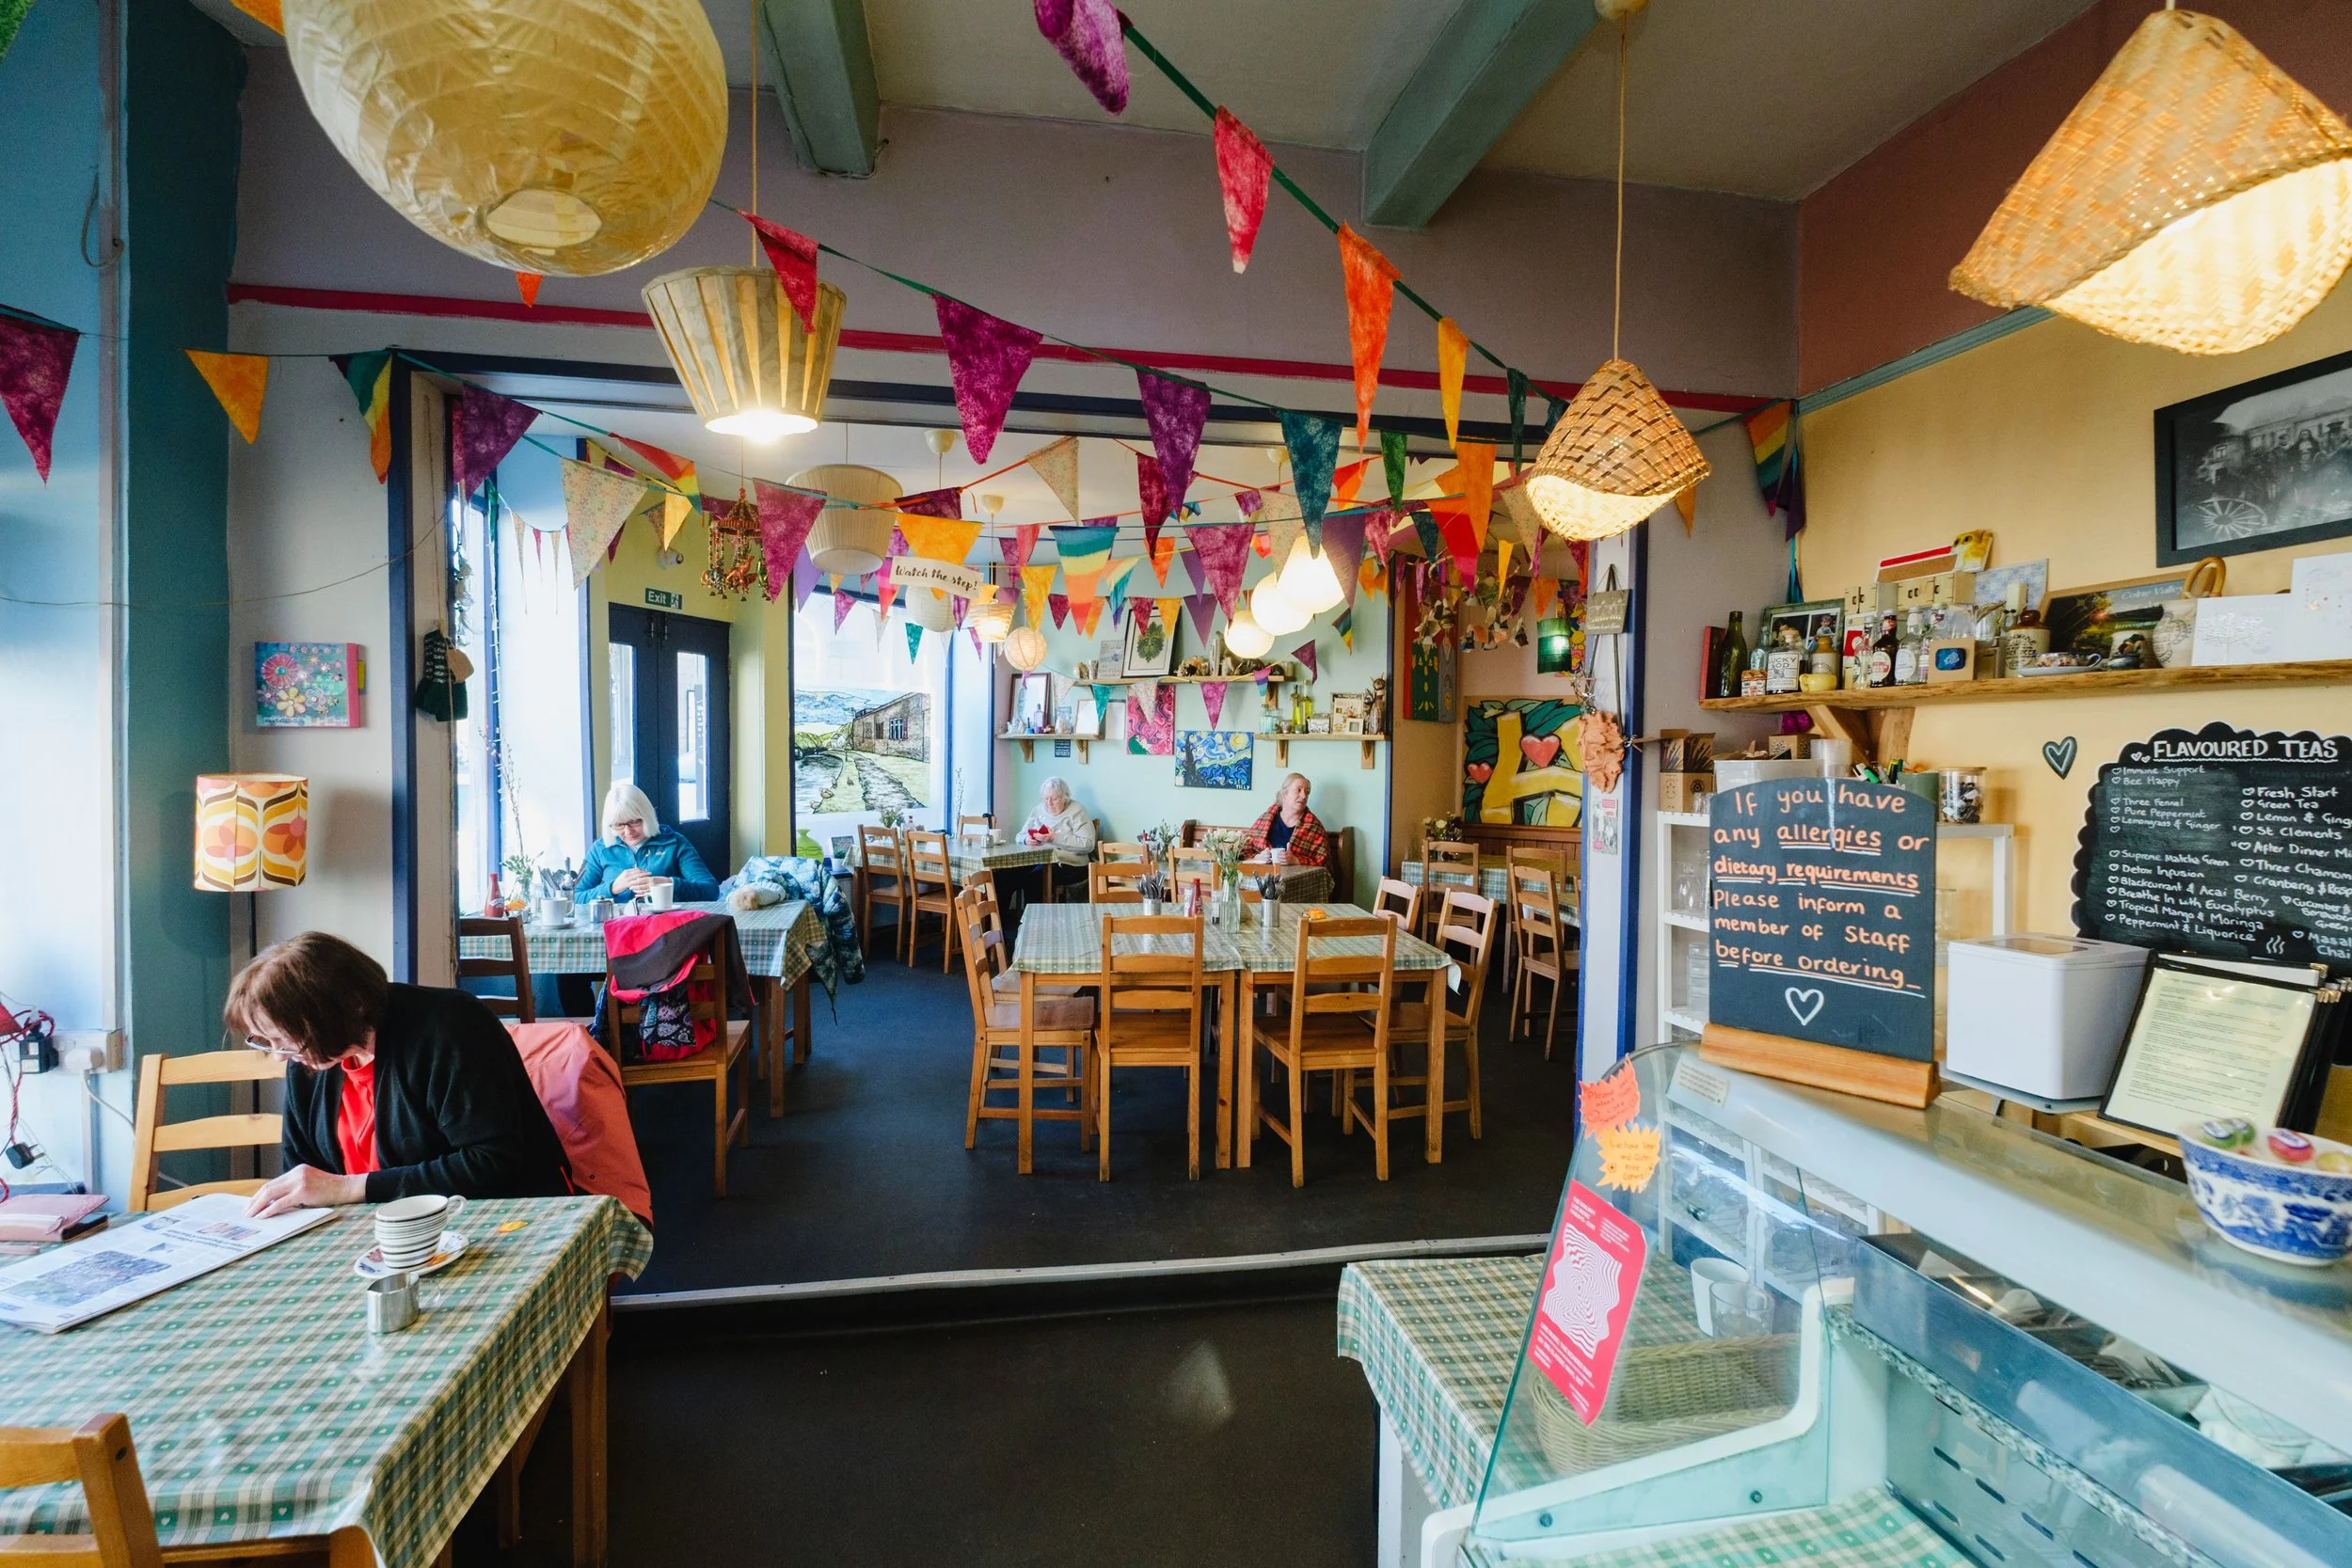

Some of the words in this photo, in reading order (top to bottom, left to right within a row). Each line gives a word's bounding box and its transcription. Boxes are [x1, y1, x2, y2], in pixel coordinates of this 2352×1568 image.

[896, 565, 928, 578] Watch
[931, 568, 947, 581] the
[950, 576, 978, 591] step!
[648, 591, 666, 604] Exit
[2153, 740, 2267, 758] FLAVOURED
[2278, 740, 2339, 758] TEAS
[2122, 767, 2158, 775] Immune
[2163, 765, 2205, 776] Support
[2123, 777, 2143, 785] Bee
[2147, 776, 2180, 787] Happy
[1734, 791, 1758, 816] If
[1777, 788, 1823, 814] you
[1838, 784, 1906, 814] have
[2257, 786, 2296, 799] Fresh
[2301, 786, 2339, 798] Start
[2122, 798, 2151, 806] Three
[2257, 800, 2291, 809] Green
[2295, 799, 2319, 809] Tea
[2124, 806, 2147, 816] Pure
[2150, 808, 2207, 819] Peppermint
[2256, 813, 2296, 822] Lemon
[2303, 812, 2314, 823] &
[2322, 813, 2352, 829] Ging
[2122, 816, 2170, 828] Lemongrass
[2173, 819, 2182, 830] &
[2185, 820, 2220, 831] Ginger
[1713, 826, 1761, 849] any
[1776, 823, 1882, 851] allergies
[1897, 833, 1931, 851] or
[2256, 827, 2274, 836] St
[2280, 827, 2343, 840] Clements
[2122, 849, 2161, 862] Supreme
[2165, 853, 2200, 864] Matcha
[2201, 854, 2230, 866] Green
[2253, 841, 2284, 855] After
[2289, 844, 2329, 858] Dinner
[2334, 847, 2352, 858] Mi
[1713, 854, 1776, 885] dietary
[1786, 862, 1919, 890] requirements
[2122, 864, 2153, 875] Detox
[2157, 865, 2204, 879] Infusion
[2255, 859, 2290, 873] Three
[2296, 863, 2352, 880] Chamom
[2121, 877, 2183, 892] Blackcurrant
[2200, 886, 2227, 897] Acai
[2233, 888, 2269, 907] Berry
[2253, 876, 2314, 895] Cranberry
[2328, 883, 2352, 897] Rasp
[1713, 889, 1780, 911] Please
[1798, 893, 1866, 915] inform
[1883, 903, 1903, 920] a
[2119, 887, 2160, 902] Breathe
[2165, 894, 2175, 904] In
[2179, 897, 2201, 909] with
[2205, 899, 2275, 917] Eucalyptus
[2119, 899, 2158, 915] Tropical
[2162, 906, 2194, 923] Mango
[2211, 913, 2265, 931] Moringa
[1714, 916, 1789, 937] member
[1801, 924, 1824, 941] of
[2119, 913, 2180, 930] Peppermint
[2195, 924, 2256, 941] Liquorice
[2308, 931, 2352, 947] Masal
[1714, 939, 1784, 965] before
[2317, 945, 2351, 959] Chai
